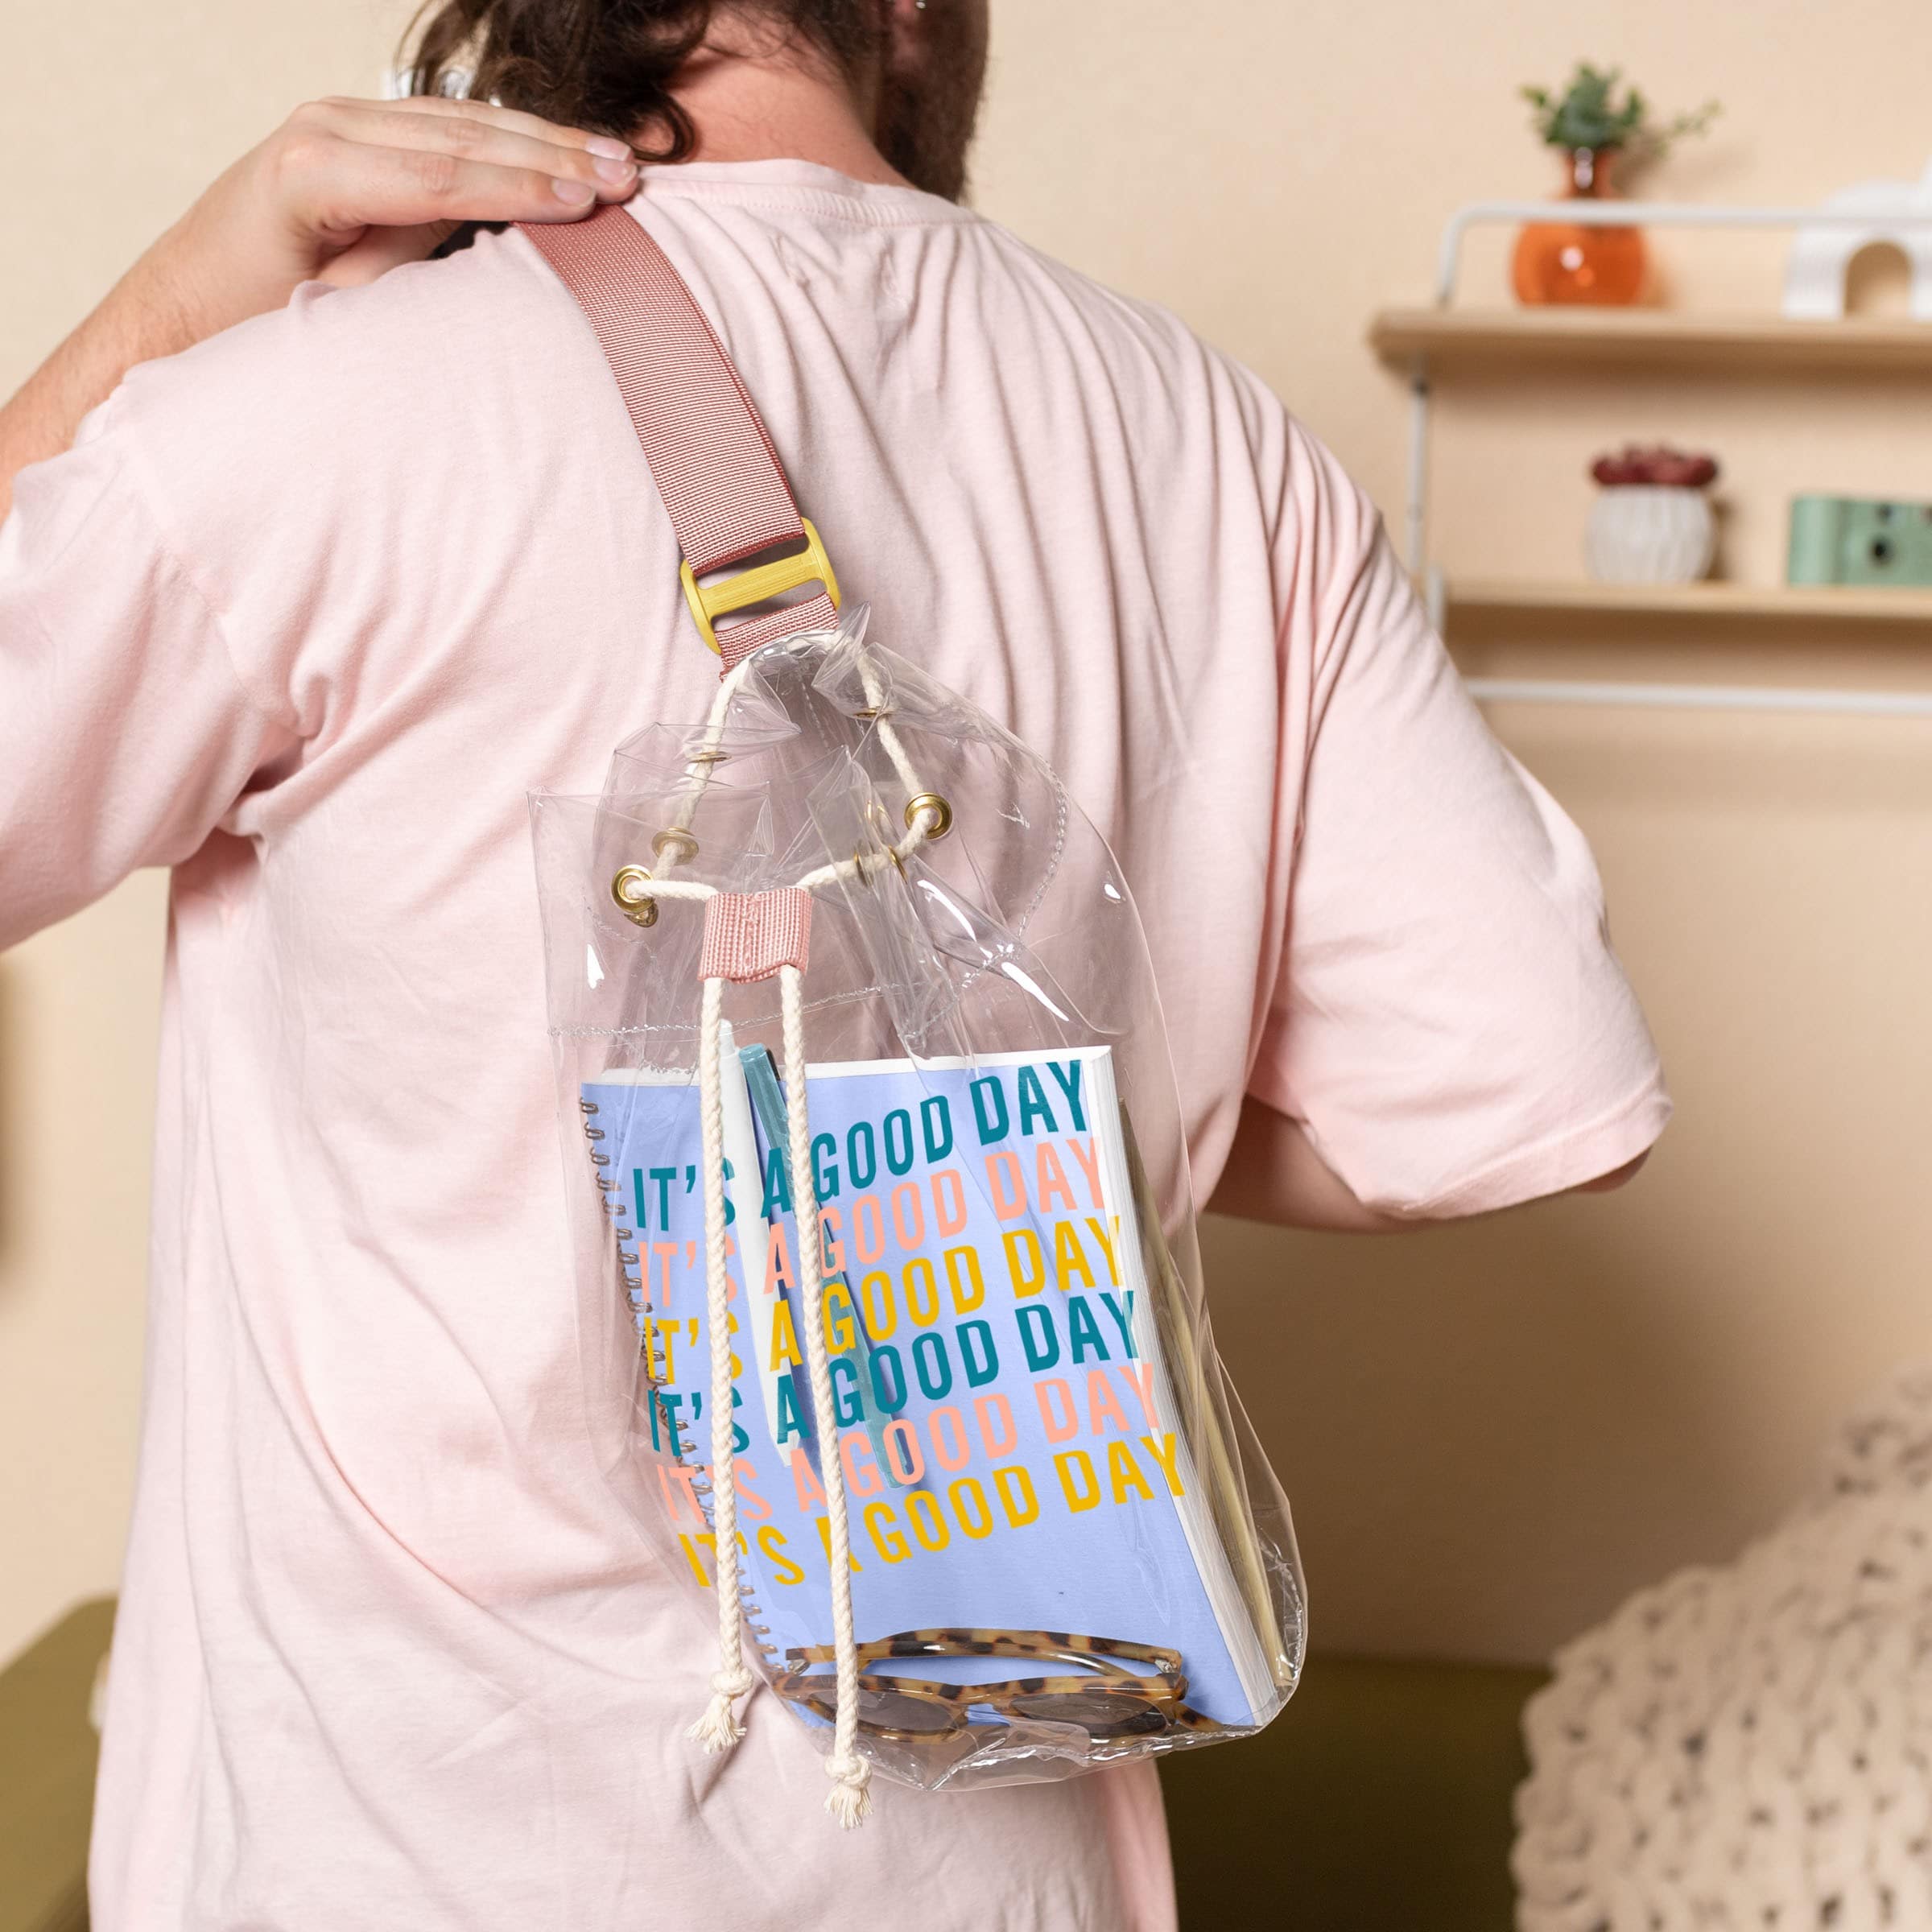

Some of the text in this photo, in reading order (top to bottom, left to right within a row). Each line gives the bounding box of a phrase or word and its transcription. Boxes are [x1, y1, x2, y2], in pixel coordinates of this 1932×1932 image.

[761, 1147, 792, 1218] A
[810, 1095, 953, 1202] GOOD
[969, 1059, 1087, 1146] DAY
[763, 1222, 796, 1294] A
[817, 1169, 967, 1278] GOOD
[985, 1137, 1105, 1221] DAY
[770, 1299, 803, 1372] A
[822, 1245, 985, 1355] GOOD
[1001, 1216, 1124, 1299] DAY
[777, 1374, 811, 1444] A
[828, 1319, 999, 1428] GOOD
[1015, 1290, 1138, 1373] DAY
[791, 1447, 827, 1512] A
[840, 1393, 1018, 1497] GOOD
[1034, 1363, 1159, 1444] DAY
[863, 1465, 1040, 1563] GOOD
[1053, 1433, 1185, 1513] DAY
